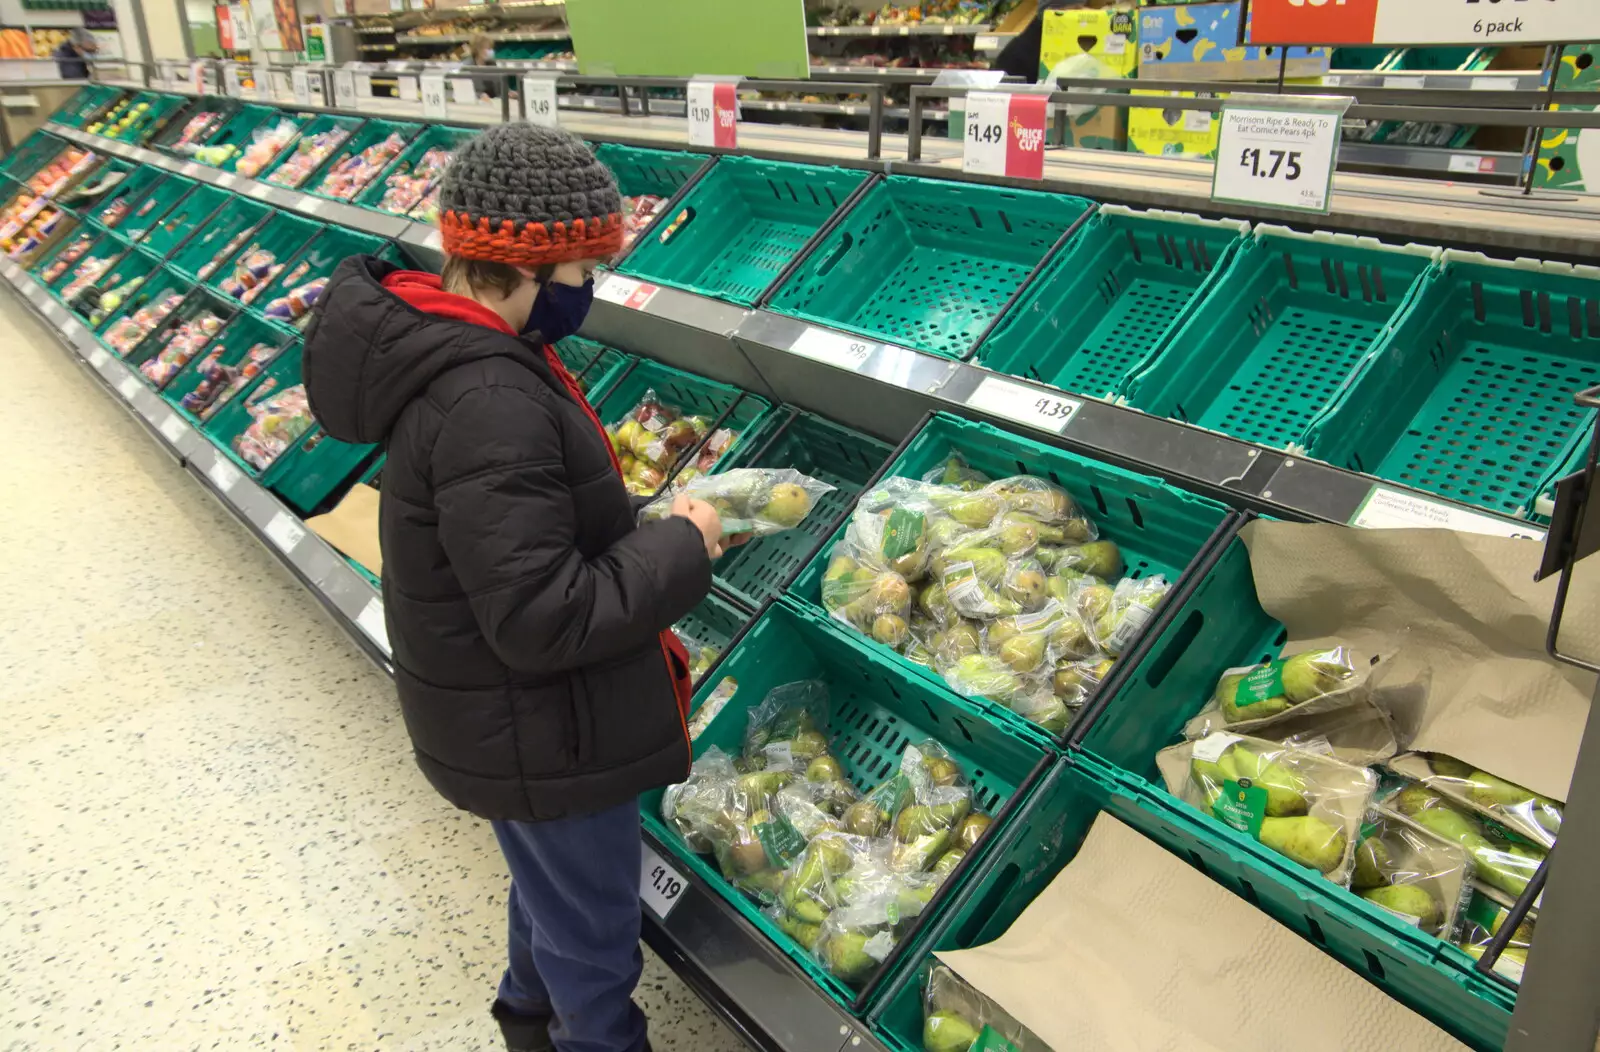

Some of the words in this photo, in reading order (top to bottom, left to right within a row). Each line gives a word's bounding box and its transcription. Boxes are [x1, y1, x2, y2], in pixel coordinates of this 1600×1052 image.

[1473, 19, 1482, 33] 6
[1485, 17, 1523, 37] pack
[691, 107, 710, 122] £1.19
[1229, 114, 1265, 125] Morrisons
[1266, 116, 1281, 127] Ripe
[1292, 119, 1316, 129] Ready
[1318, 119, 1328, 129] To
[968, 123, 1002, 144] £1.49
[1017, 127, 1043, 141] PRICE
[1237, 124, 1249, 133] Eat
[1280, 126, 1300, 136] Pears
[1301, 128, 1317, 139] 4pk
[1018, 139, 1040, 152] CUT
[1240, 148, 1302, 181] £1.75
[848, 343, 866, 360] 99p
[1035, 398, 1073, 419] £1.39
[1373, 499, 1410, 512] Conference
[651, 865, 681, 900] £1.19
